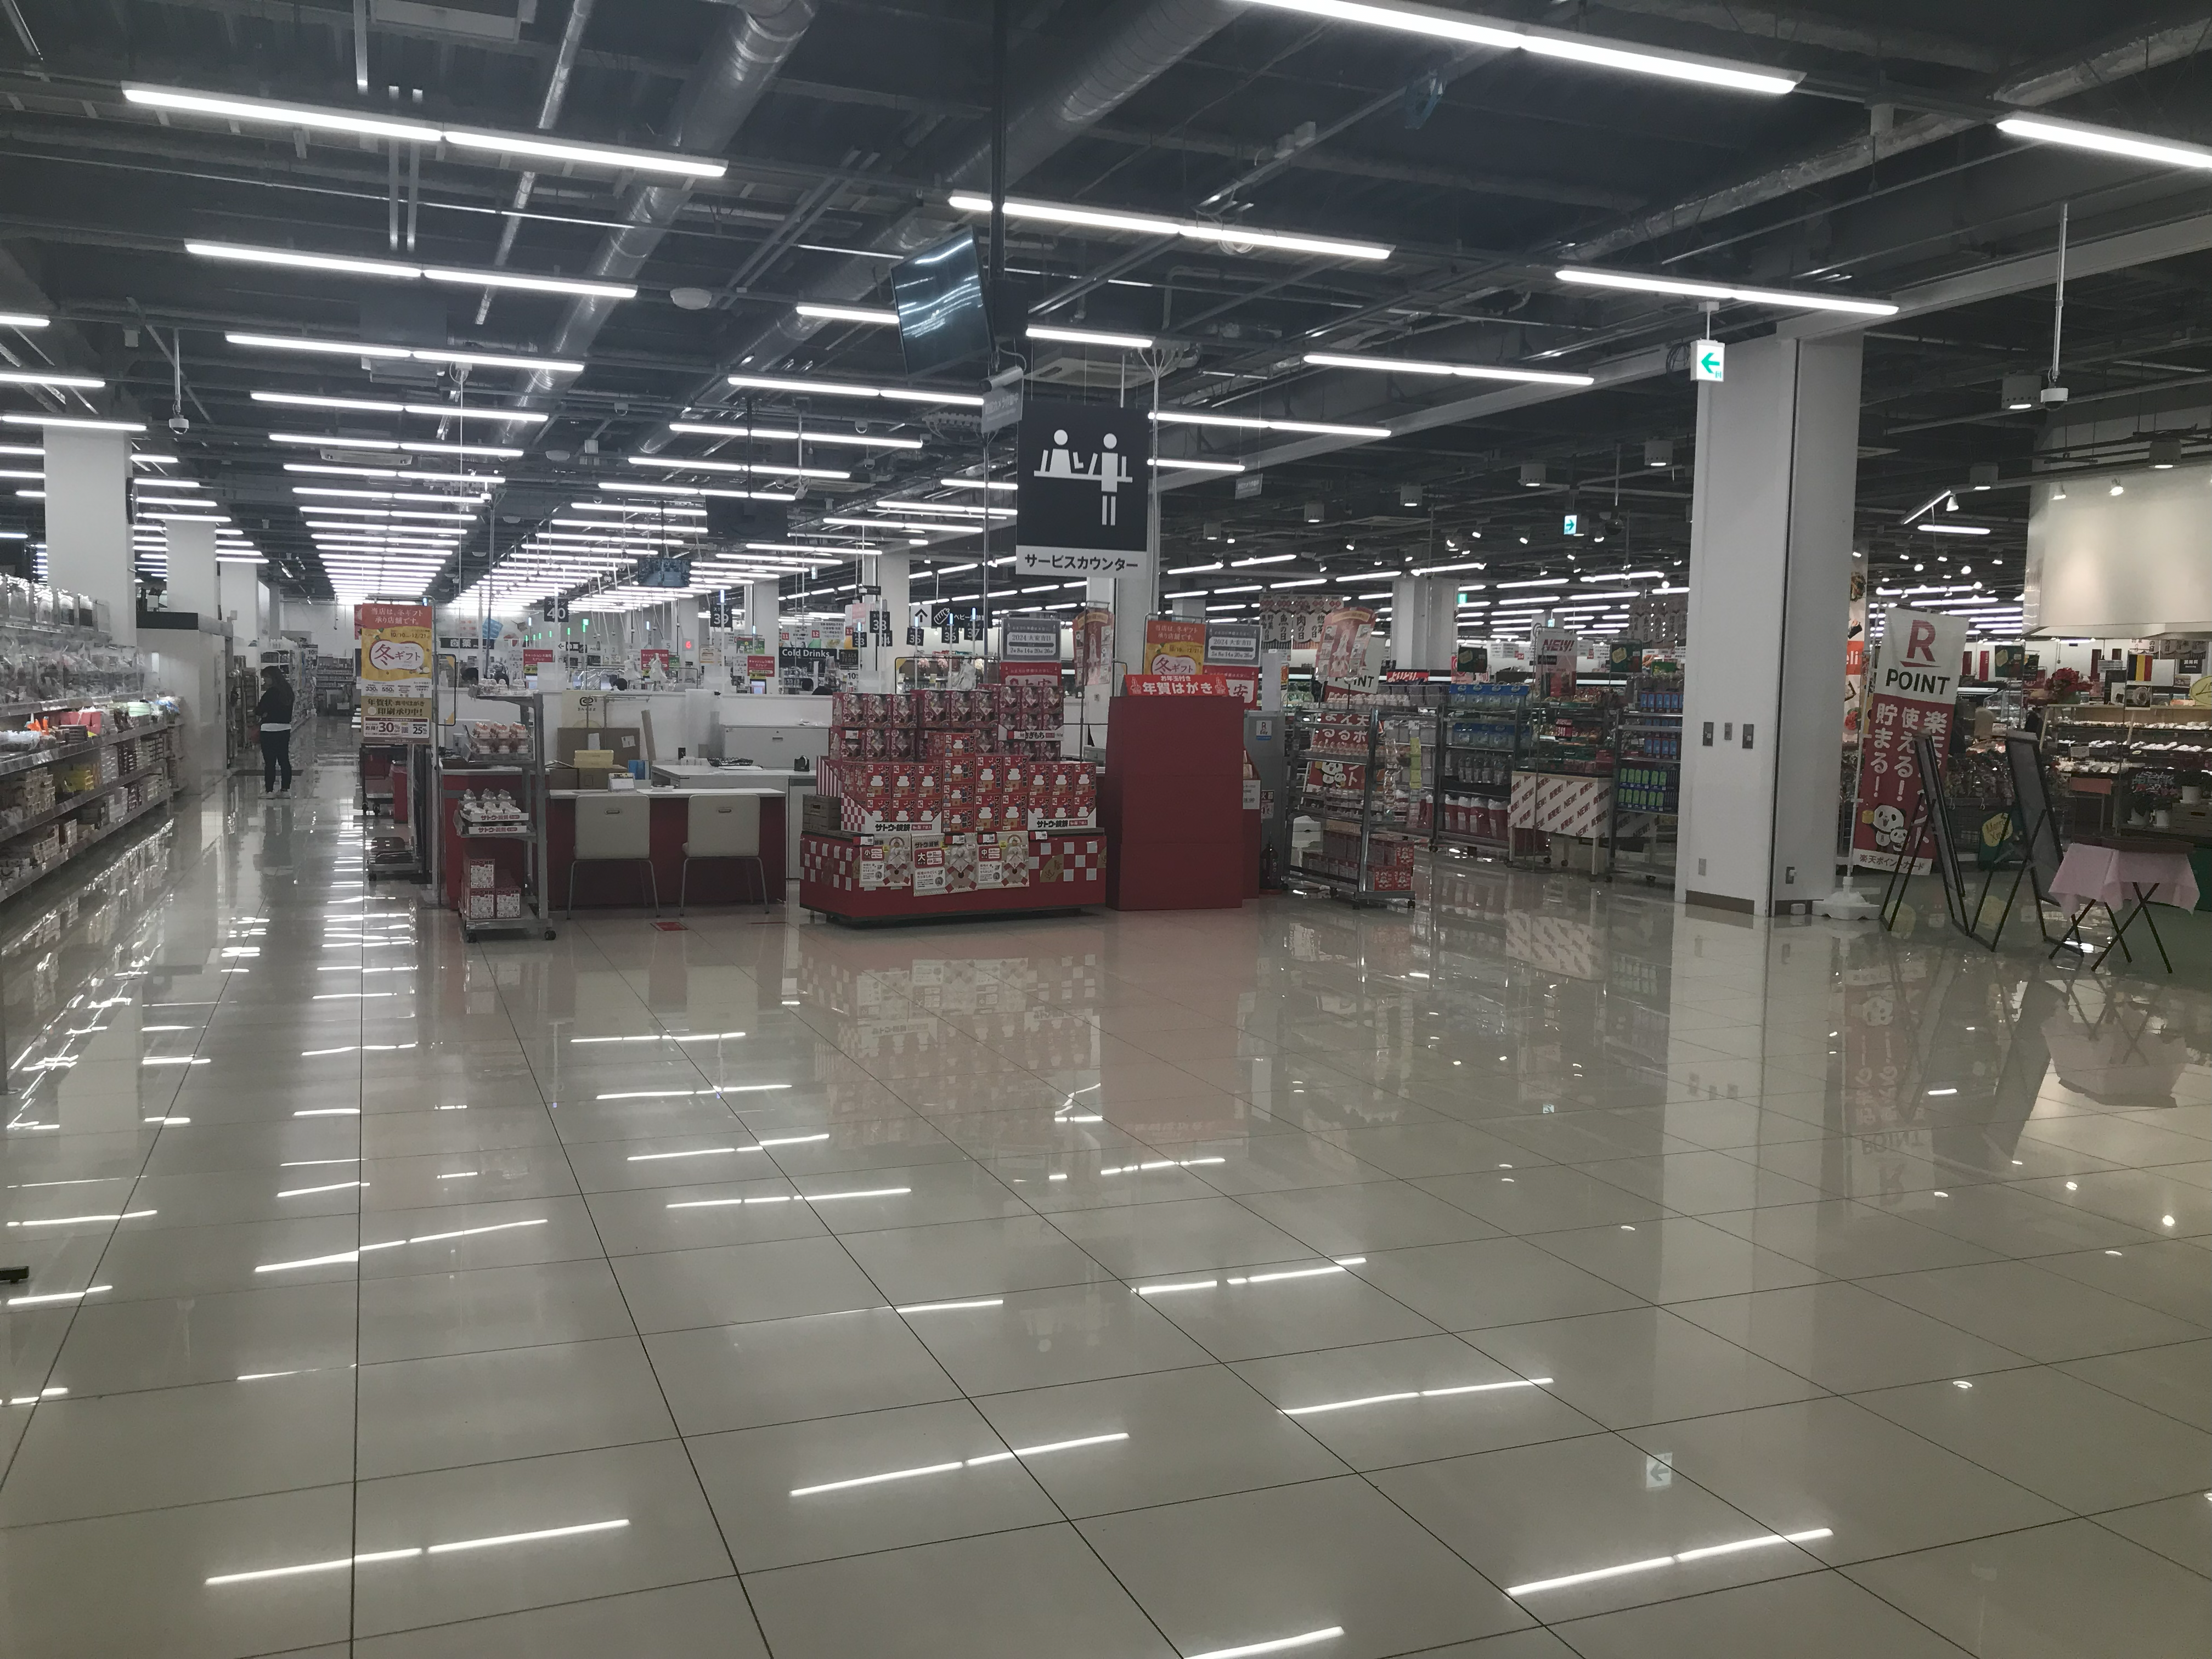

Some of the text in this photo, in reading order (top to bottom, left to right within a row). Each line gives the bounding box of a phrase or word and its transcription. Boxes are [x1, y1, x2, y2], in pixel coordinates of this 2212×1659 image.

[1025, 554, 1138, 571] サービスカウンター
[547, 607, 566, 619] 40
[714, 613, 729, 624] 39
[873, 620, 887, 630] 38
[967, 628, 980, 637] 37
[1279, 614, 1289, 641] 魚の日
[1296, 616, 1306, 640] 肉の日
[910, 635, 921, 644] 35
[945, 632, 956, 641] 36
[1906, 620, 1936, 662] R
[1543, 639, 1575, 652] NEW!
[374, 644, 421, 665] 冬ギフト
[1154, 657, 1193, 675] 冬ギフト
[1143, 682, 1212, 695] 年賀はがき
[1886, 669, 1950, 695] POINT
[1871, 703, 1898, 798] 貯まる!
[1894, 707, 1920, 802] 使える!
[1564, 792, 1577, 809] NEW!
[1577, 802, 1590, 818] NEW!
[917, 853, 926, 862] 大
